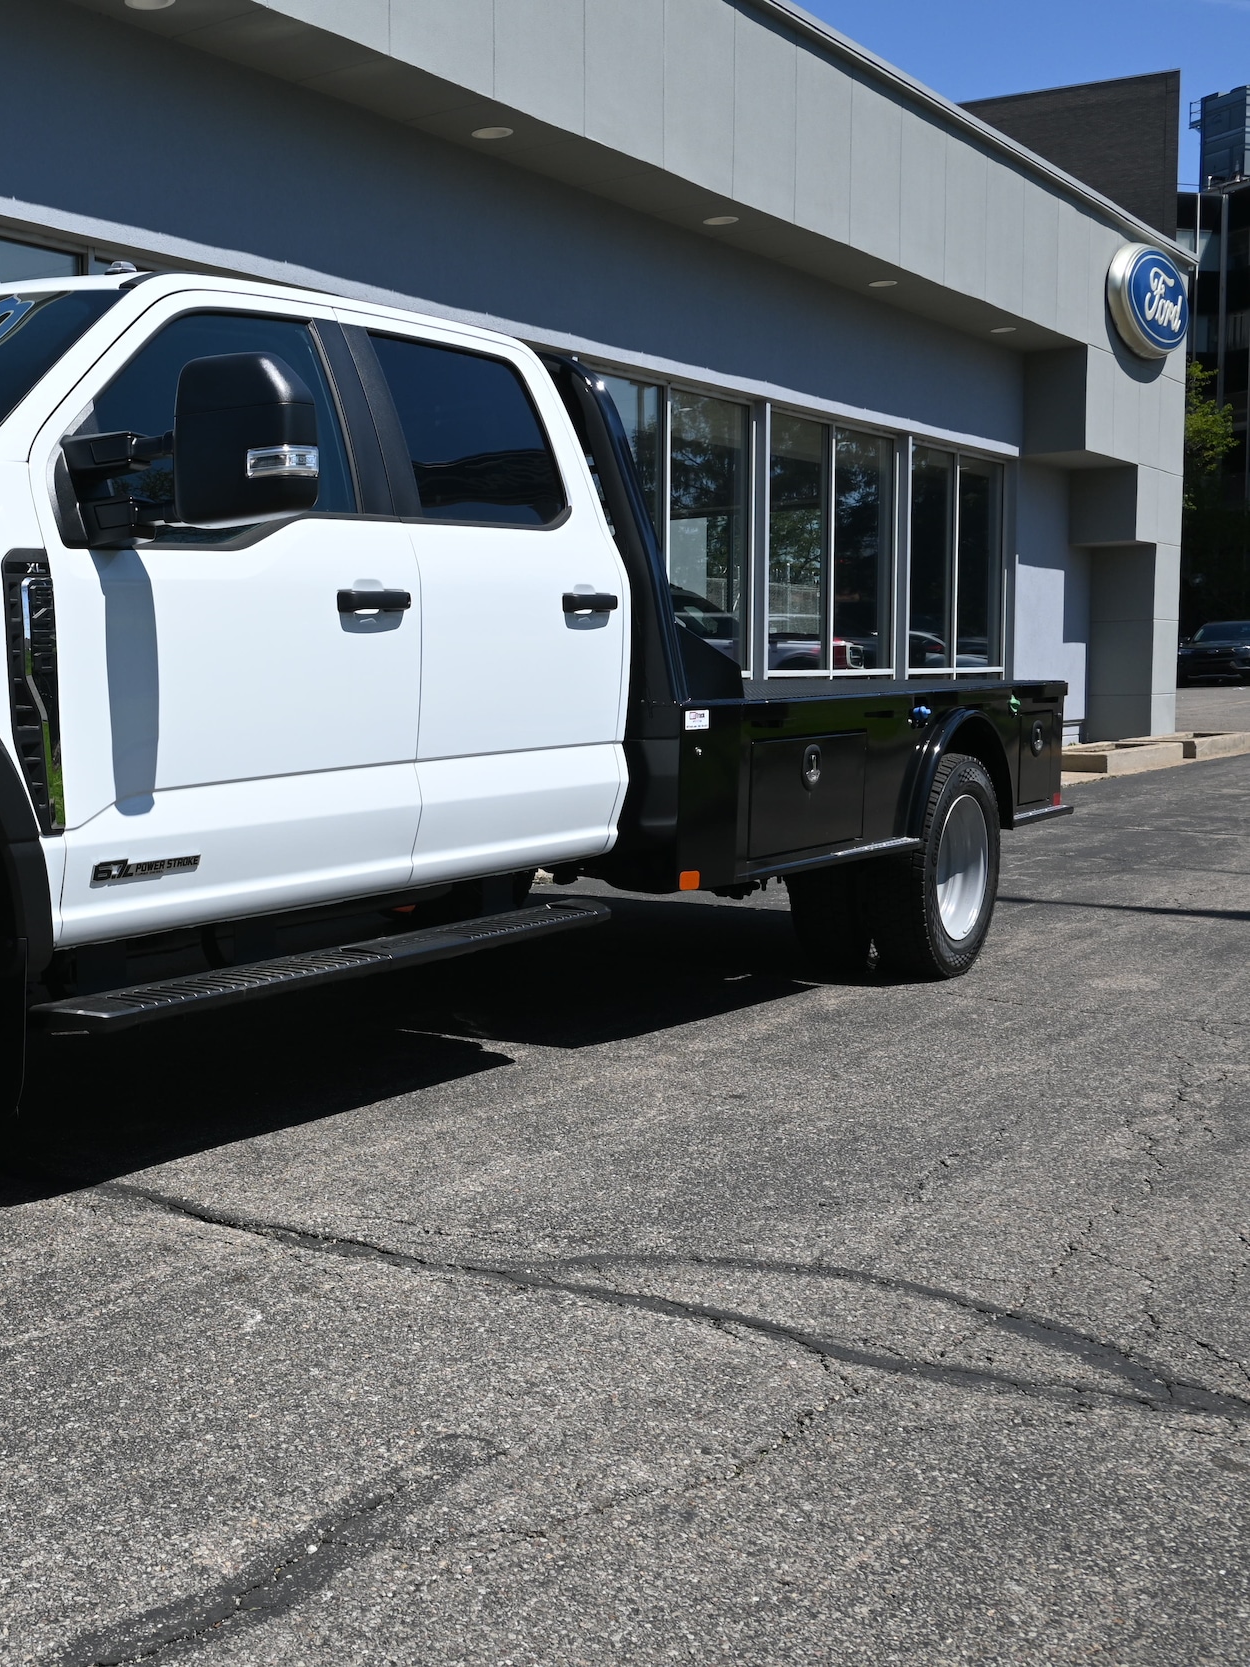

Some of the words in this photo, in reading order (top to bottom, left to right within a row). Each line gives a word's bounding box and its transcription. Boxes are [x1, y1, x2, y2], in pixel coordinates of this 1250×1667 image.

[1144, 266, 1184, 333] Ford
[26, 562, 47, 574] XL
[135, 859, 165, 872] POWER
[166, 855, 200, 868] STROKE
